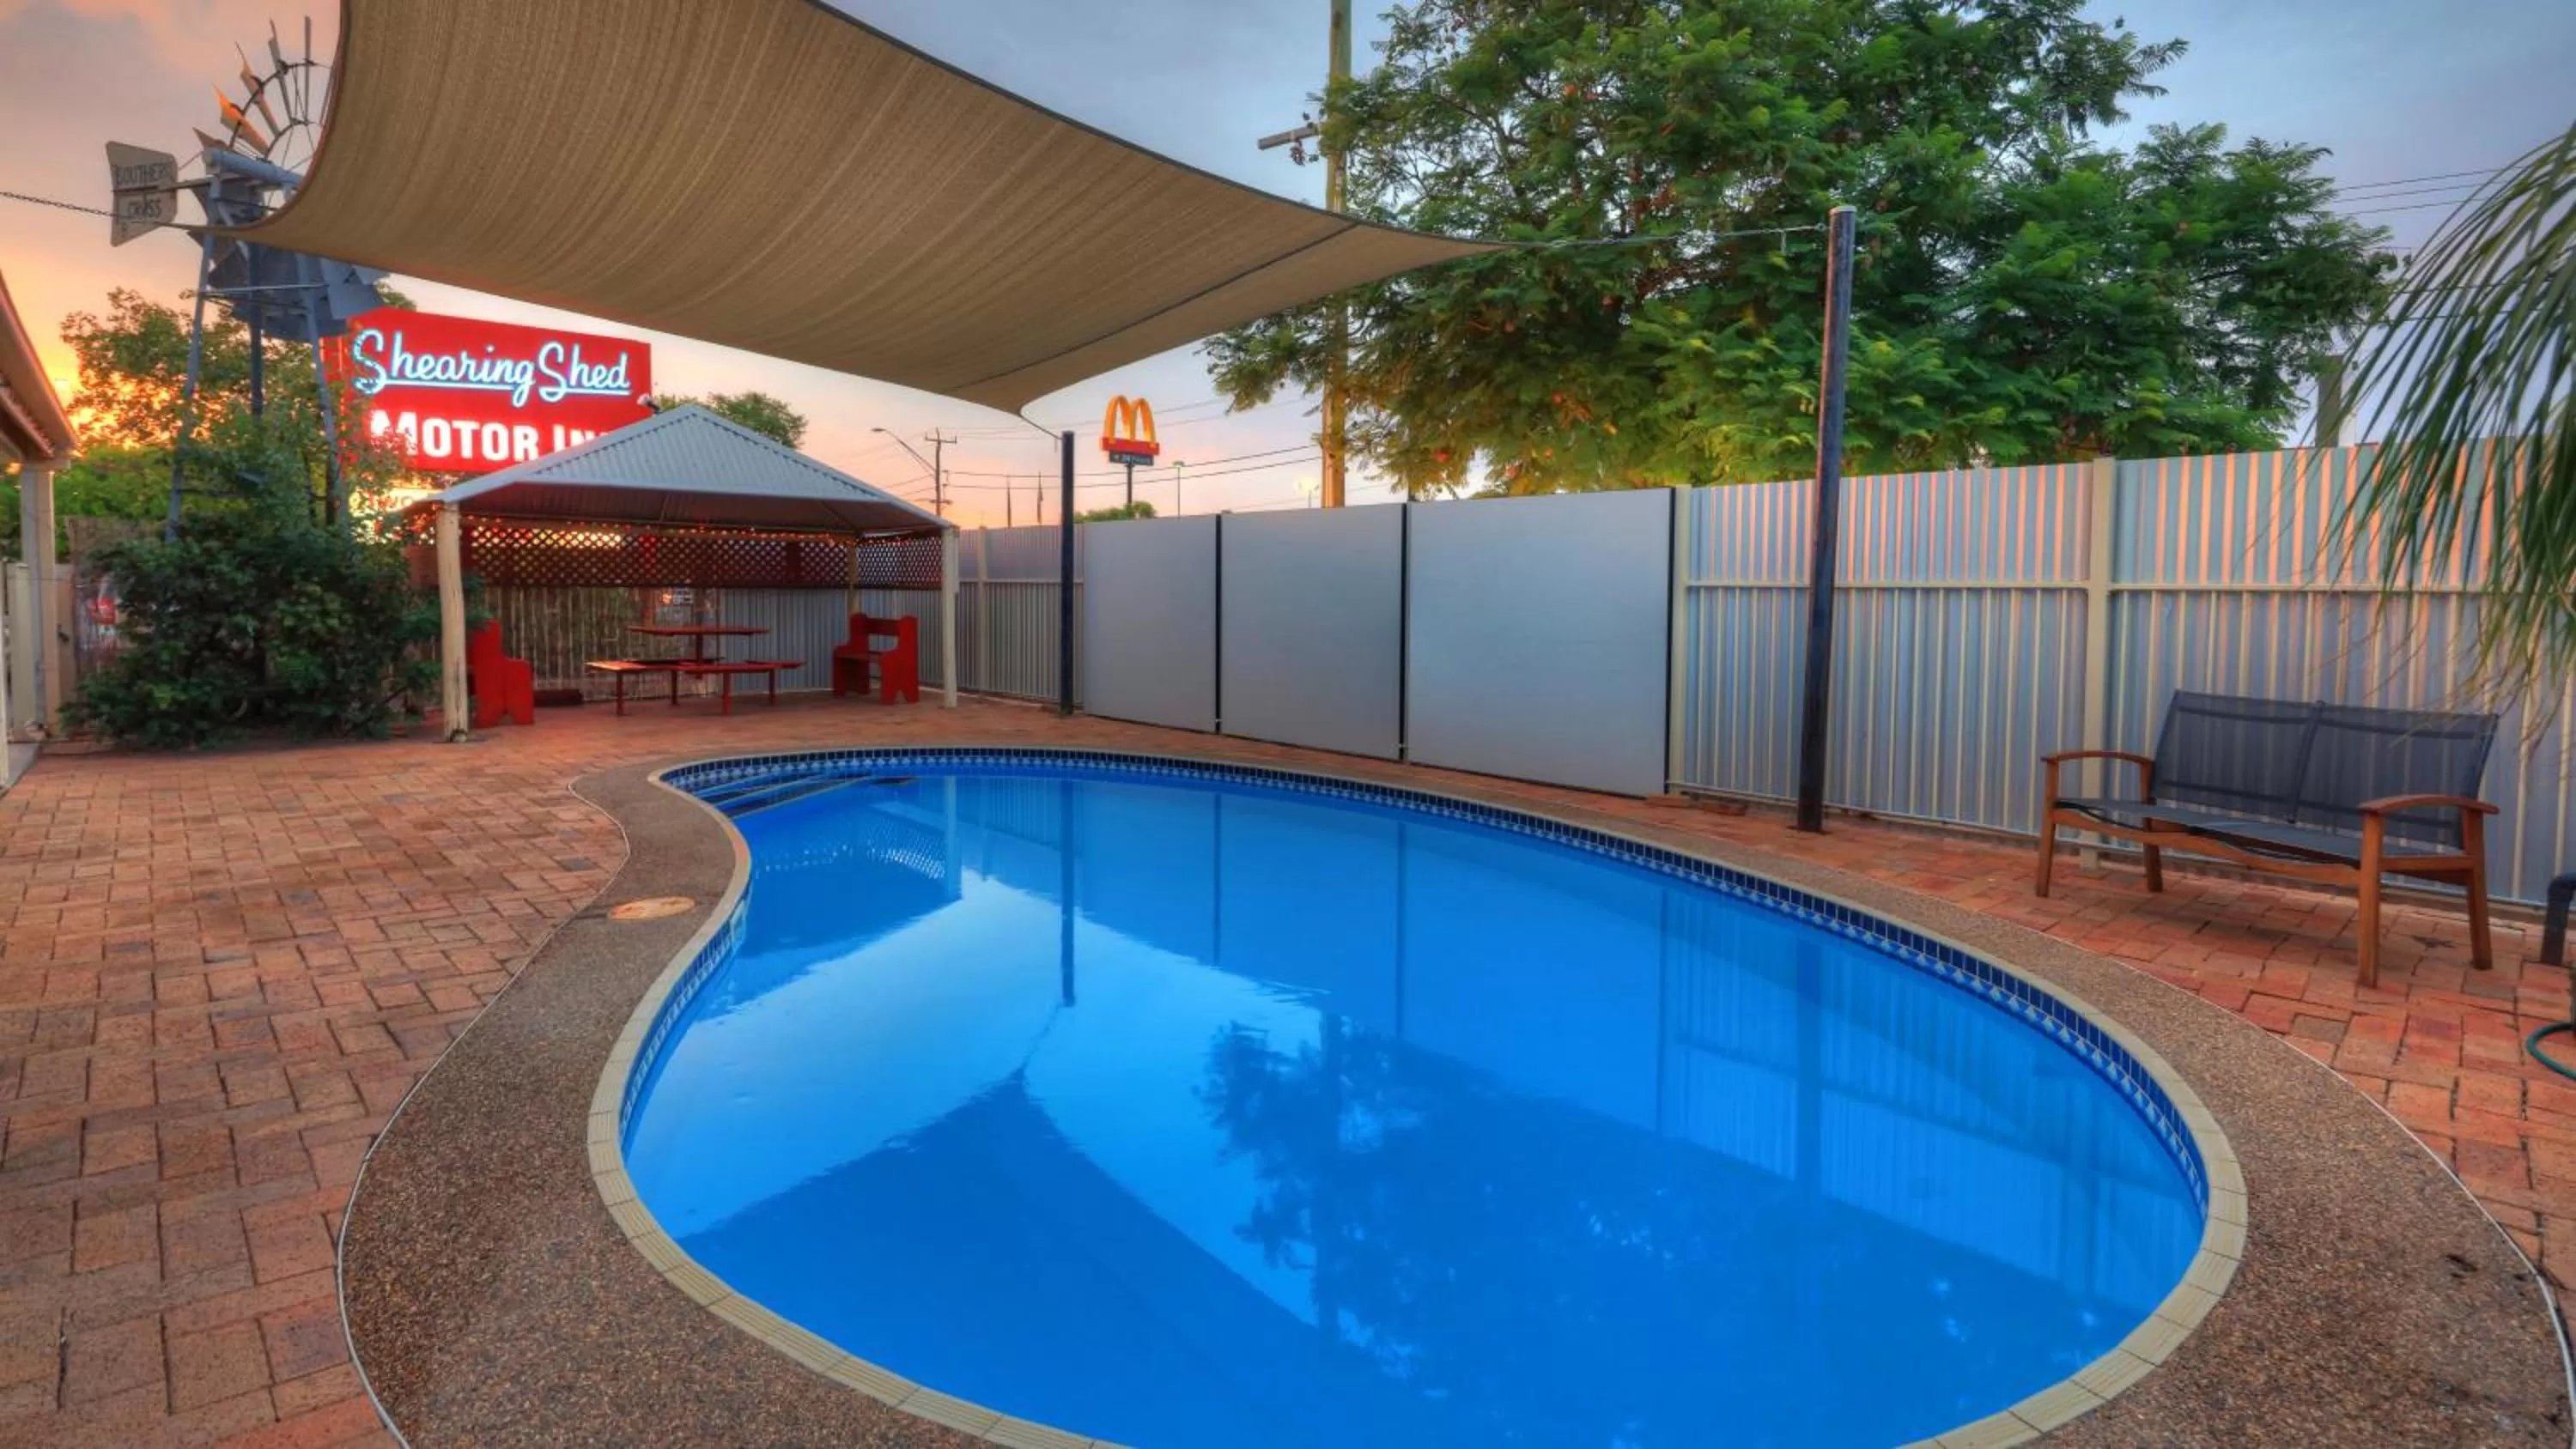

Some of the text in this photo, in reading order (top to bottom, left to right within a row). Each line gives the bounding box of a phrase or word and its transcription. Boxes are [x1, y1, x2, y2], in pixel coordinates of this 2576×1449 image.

[352, 328, 632, 408] Shearing Shed
[370, 409, 539, 461] MOTOR
